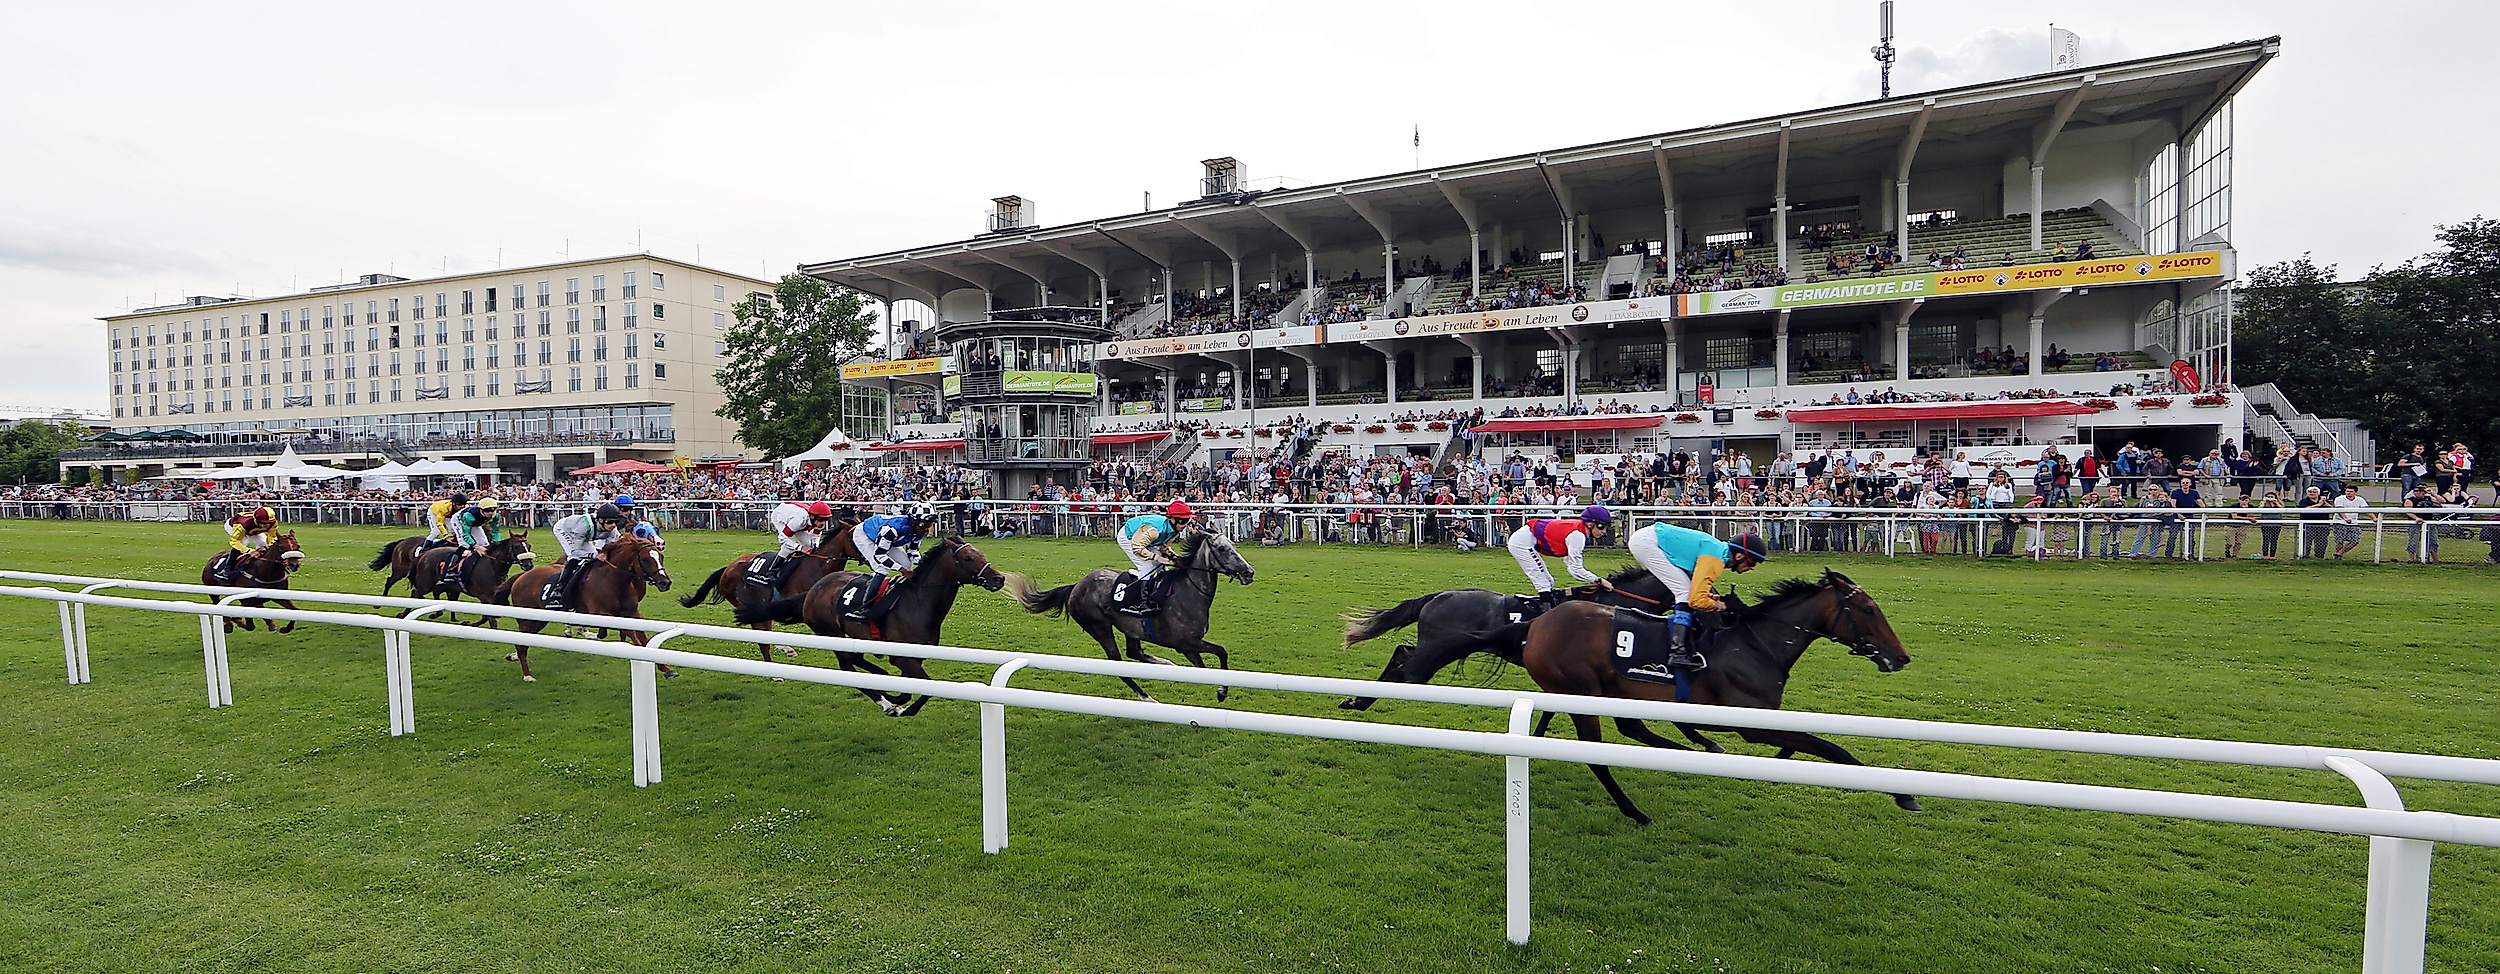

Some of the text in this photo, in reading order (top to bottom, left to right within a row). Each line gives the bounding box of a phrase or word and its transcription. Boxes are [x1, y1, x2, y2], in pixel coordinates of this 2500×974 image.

[2090, 264, 2126, 274] LOTTO
[2174, 257, 2211, 267] LOTTO
[1952, 275, 1985, 284] LOTTO
[2029, 269, 2063, 279] LOTTO
[1781, 279, 1925, 302] GERMANTOTE.DE
[1418, 323, 1439, 333] Aus
[1442, 320, 1478, 331] Freude
[1503, 317, 1520, 327] am
[1525, 313, 1558, 325] Leben
[1125, 346, 1140, 355] Aus
[1142, 343, 1169, 354] Freude
[1188, 343, 1200, 351] am
[1204, 340, 1228, 349] Leben
[1006, 381, 1050, 389] GERMANTOTE.DE
[748, 557, 766, 573] 10
[843, 587, 858, 605] 4
[1616, 630, 1634, 658] 9
